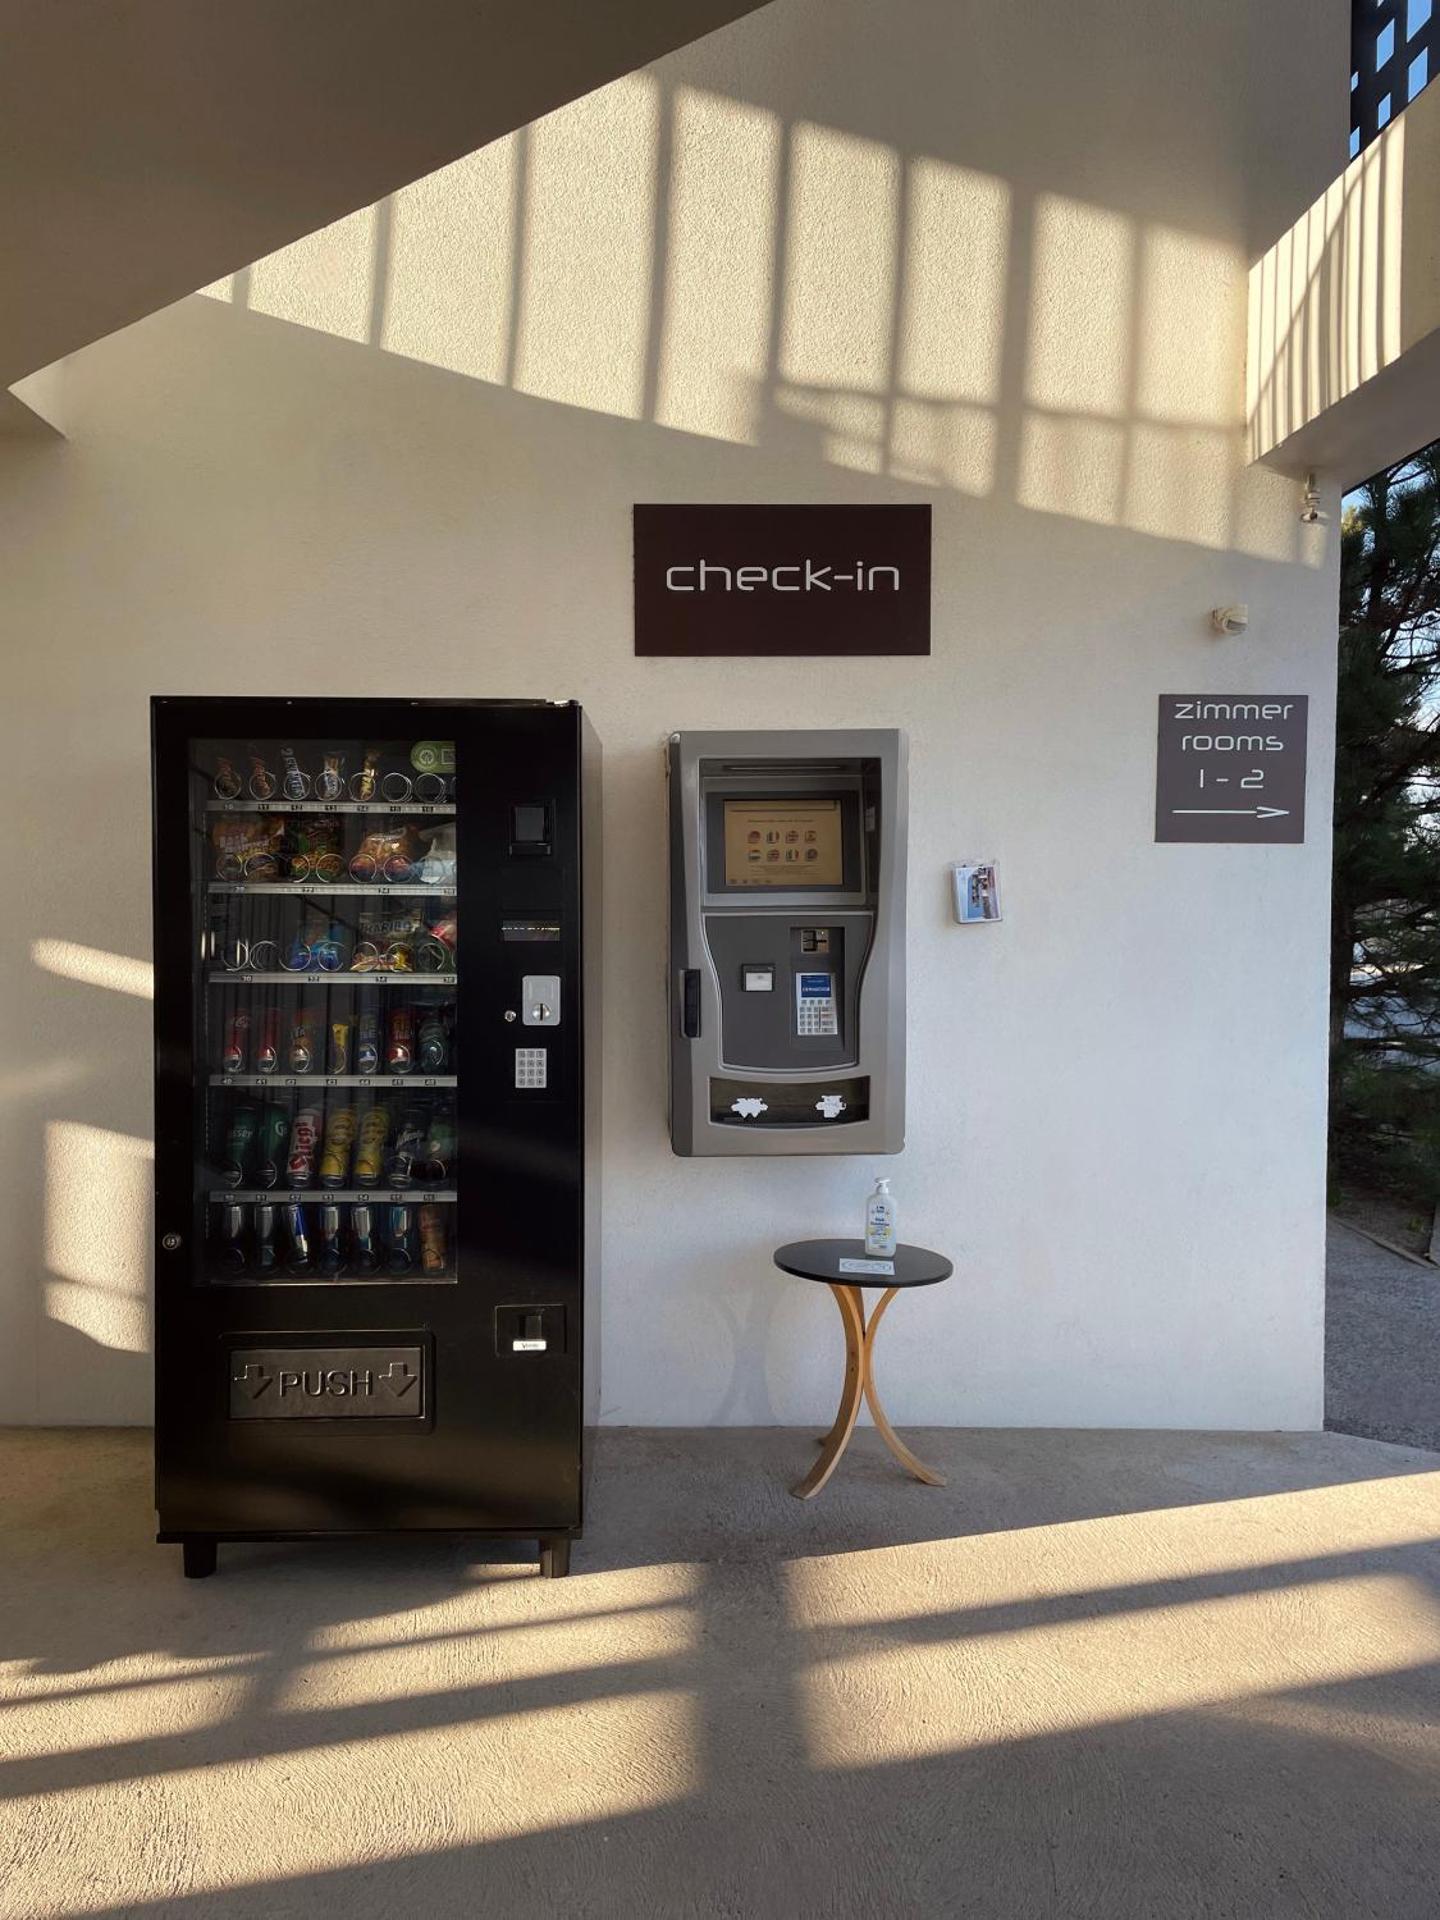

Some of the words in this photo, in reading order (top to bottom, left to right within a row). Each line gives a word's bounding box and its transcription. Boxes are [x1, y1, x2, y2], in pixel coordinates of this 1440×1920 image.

[666, 559, 900, 592] check-in
[1174, 700, 1294, 720] zimmer
[1182, 735, 1284, 751] rooms
[1240, 769, 1265, 789] 2
[279, 1370, 372, 1397] PUSH
